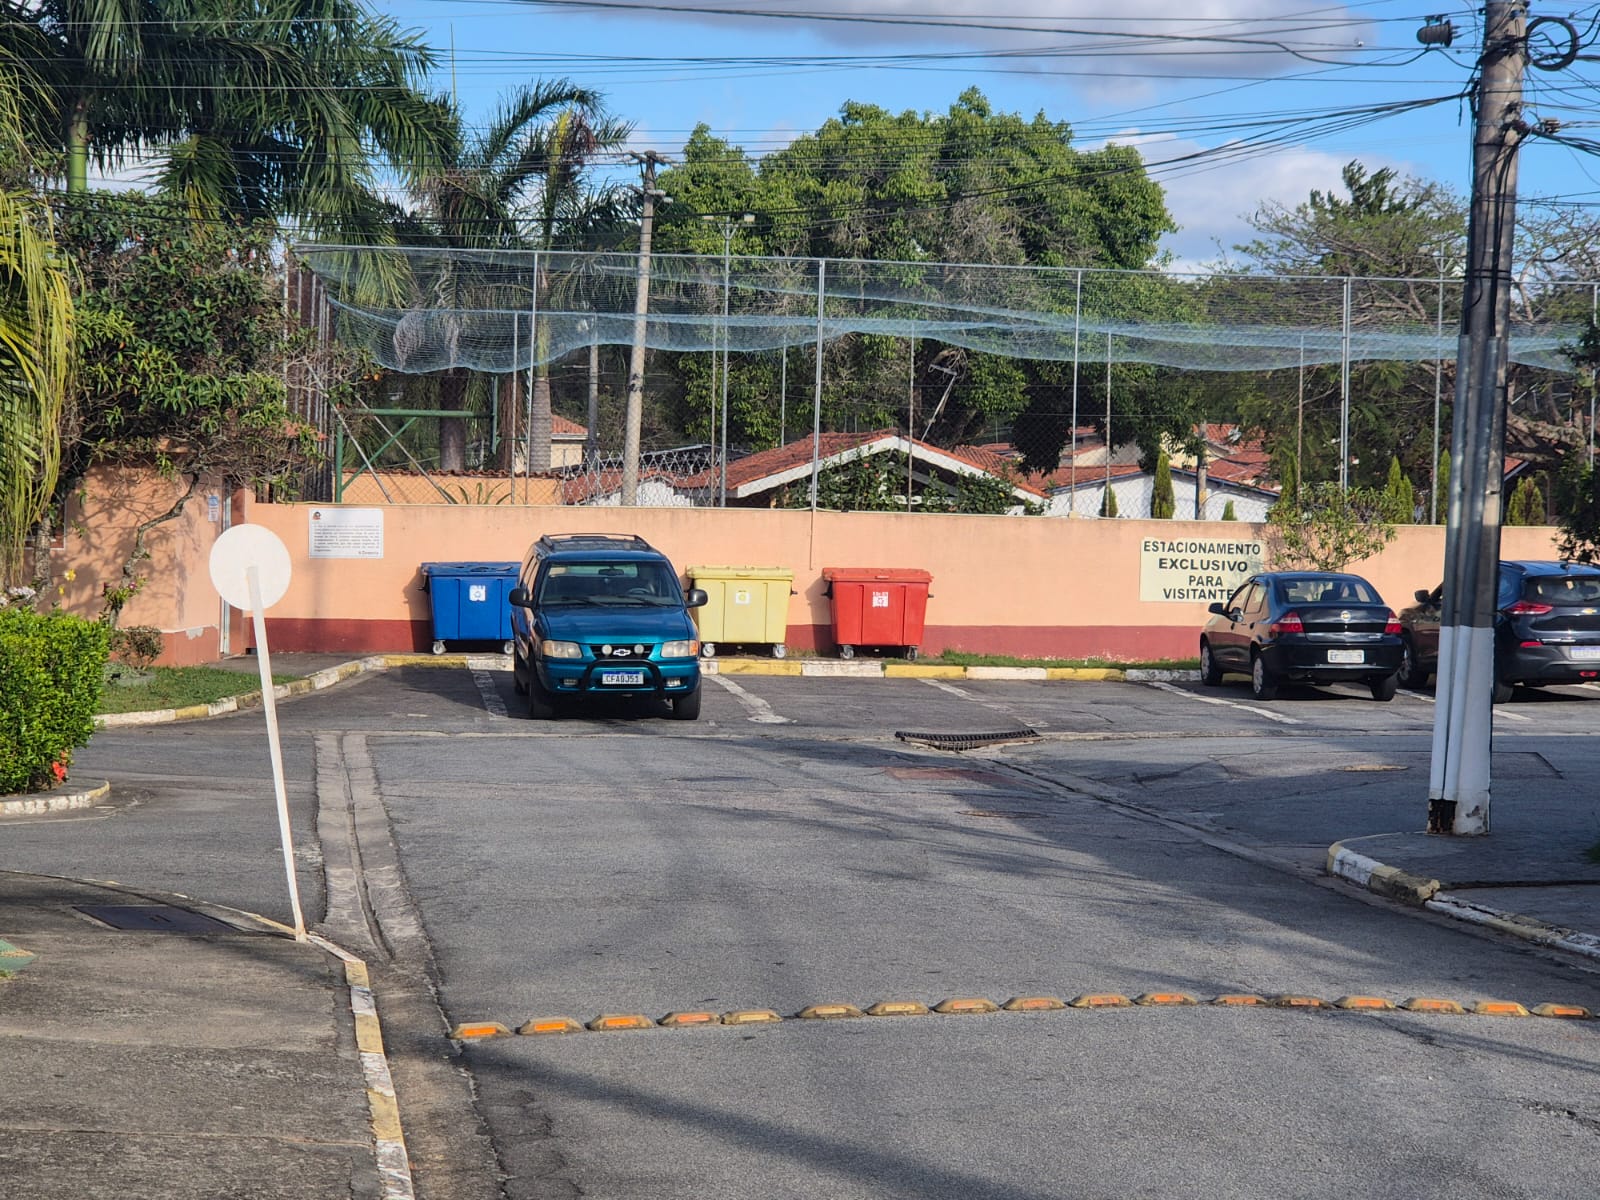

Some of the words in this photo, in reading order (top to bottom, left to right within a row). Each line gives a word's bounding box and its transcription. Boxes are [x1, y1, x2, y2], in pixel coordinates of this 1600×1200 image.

[1143, 540, 1261, 555] ESTACIONAMENTO
[1158, 558, 1248, 572] EXCLUSIVO
[1188, 575, 1224, 587] PARA
[1163, 588, 1235, 601] VISITANTE
